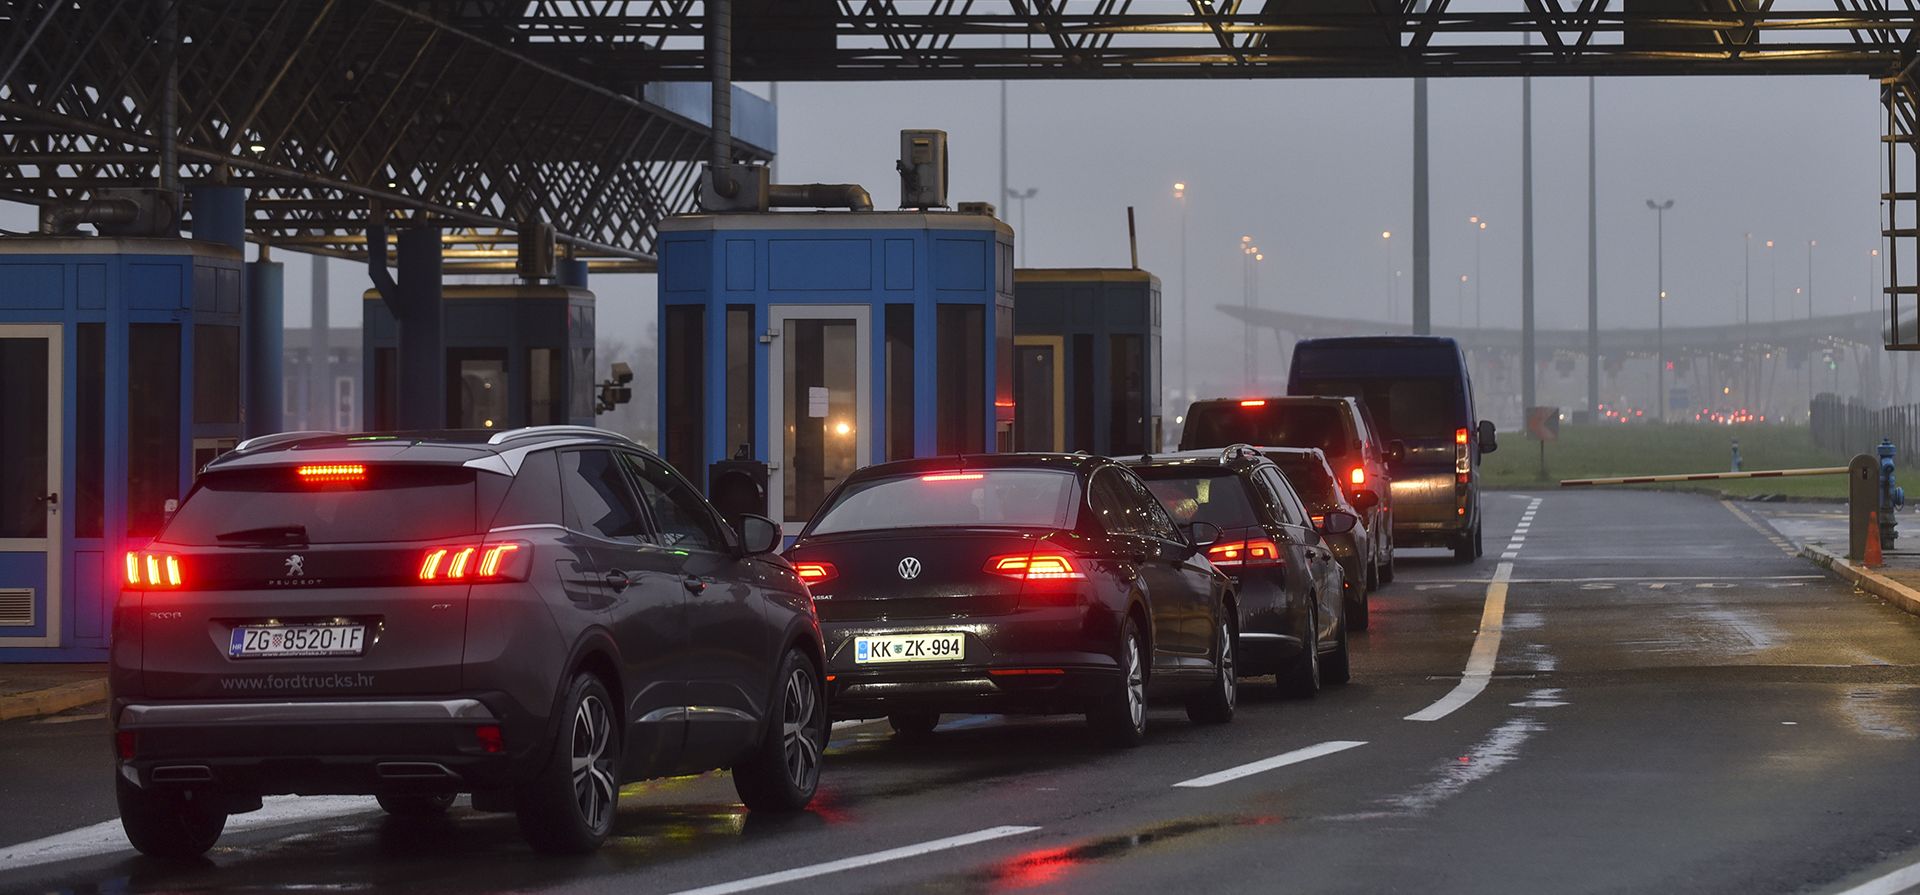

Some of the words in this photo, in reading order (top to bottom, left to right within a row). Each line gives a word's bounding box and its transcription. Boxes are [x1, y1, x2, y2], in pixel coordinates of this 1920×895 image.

[245, 630, 270, 650] ZG
[871, 640, 892, 658] KK
[905, 638, 960, 657] ZK-994
[220, 672, 375, 689] www.fordtrucks.hr
